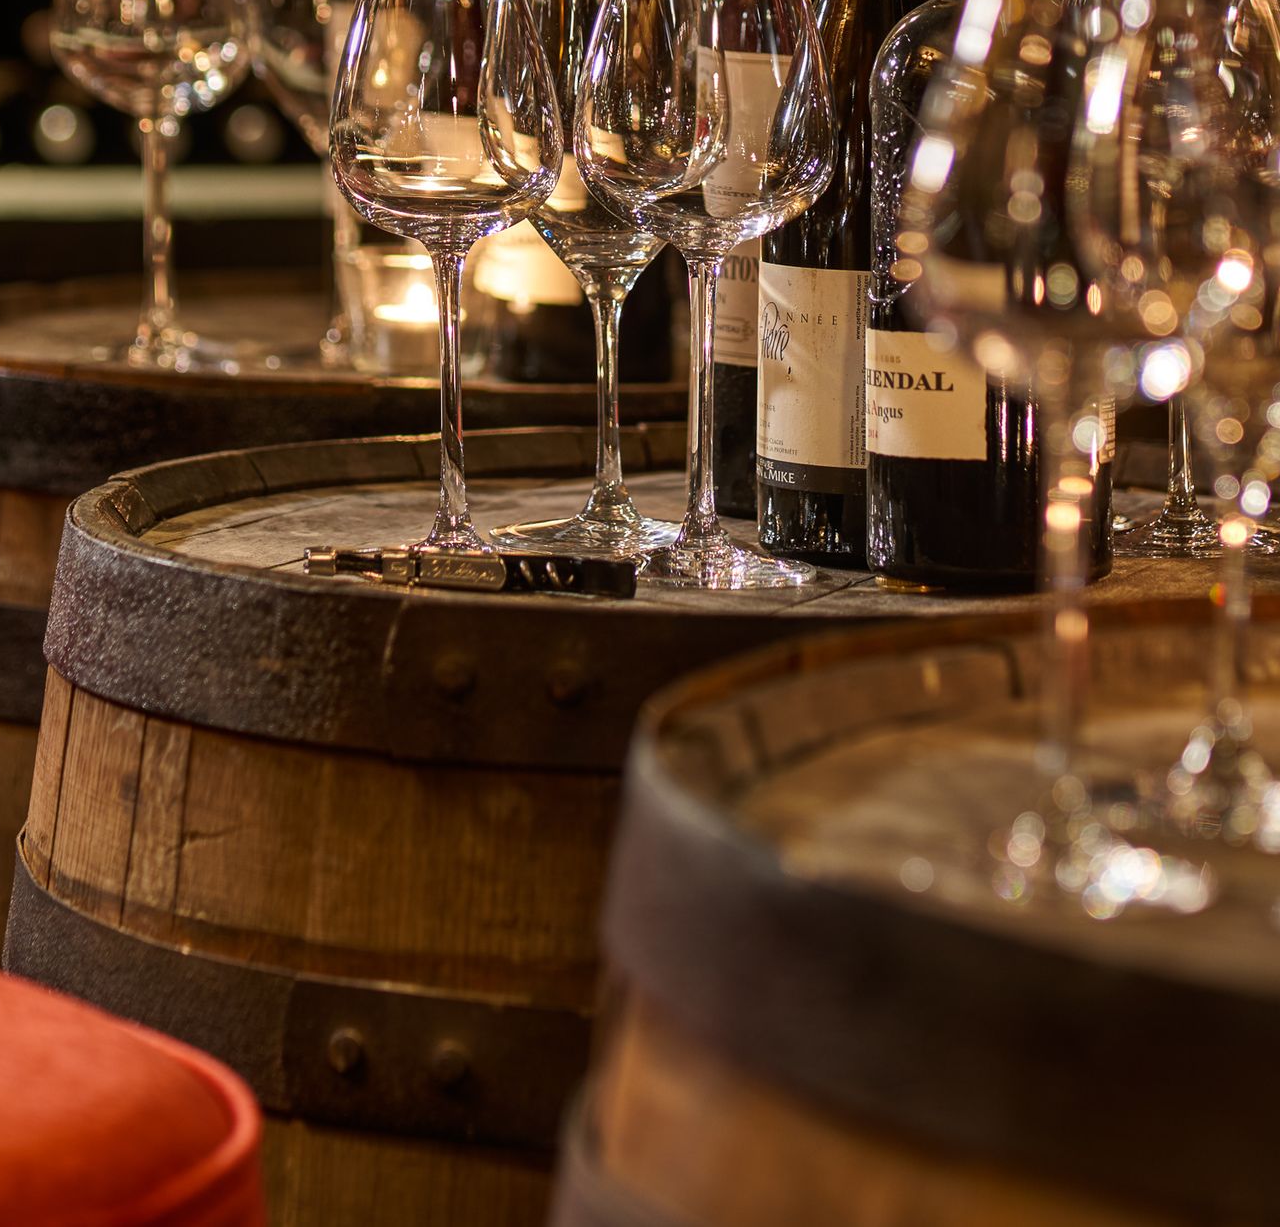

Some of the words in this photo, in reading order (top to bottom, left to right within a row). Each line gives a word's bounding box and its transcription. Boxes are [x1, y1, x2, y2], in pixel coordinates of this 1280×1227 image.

[865, 368, 954, 392] HENDAL
[871, 400, 904, 423] Angus
[768, 469, 796, 484] MIKE
